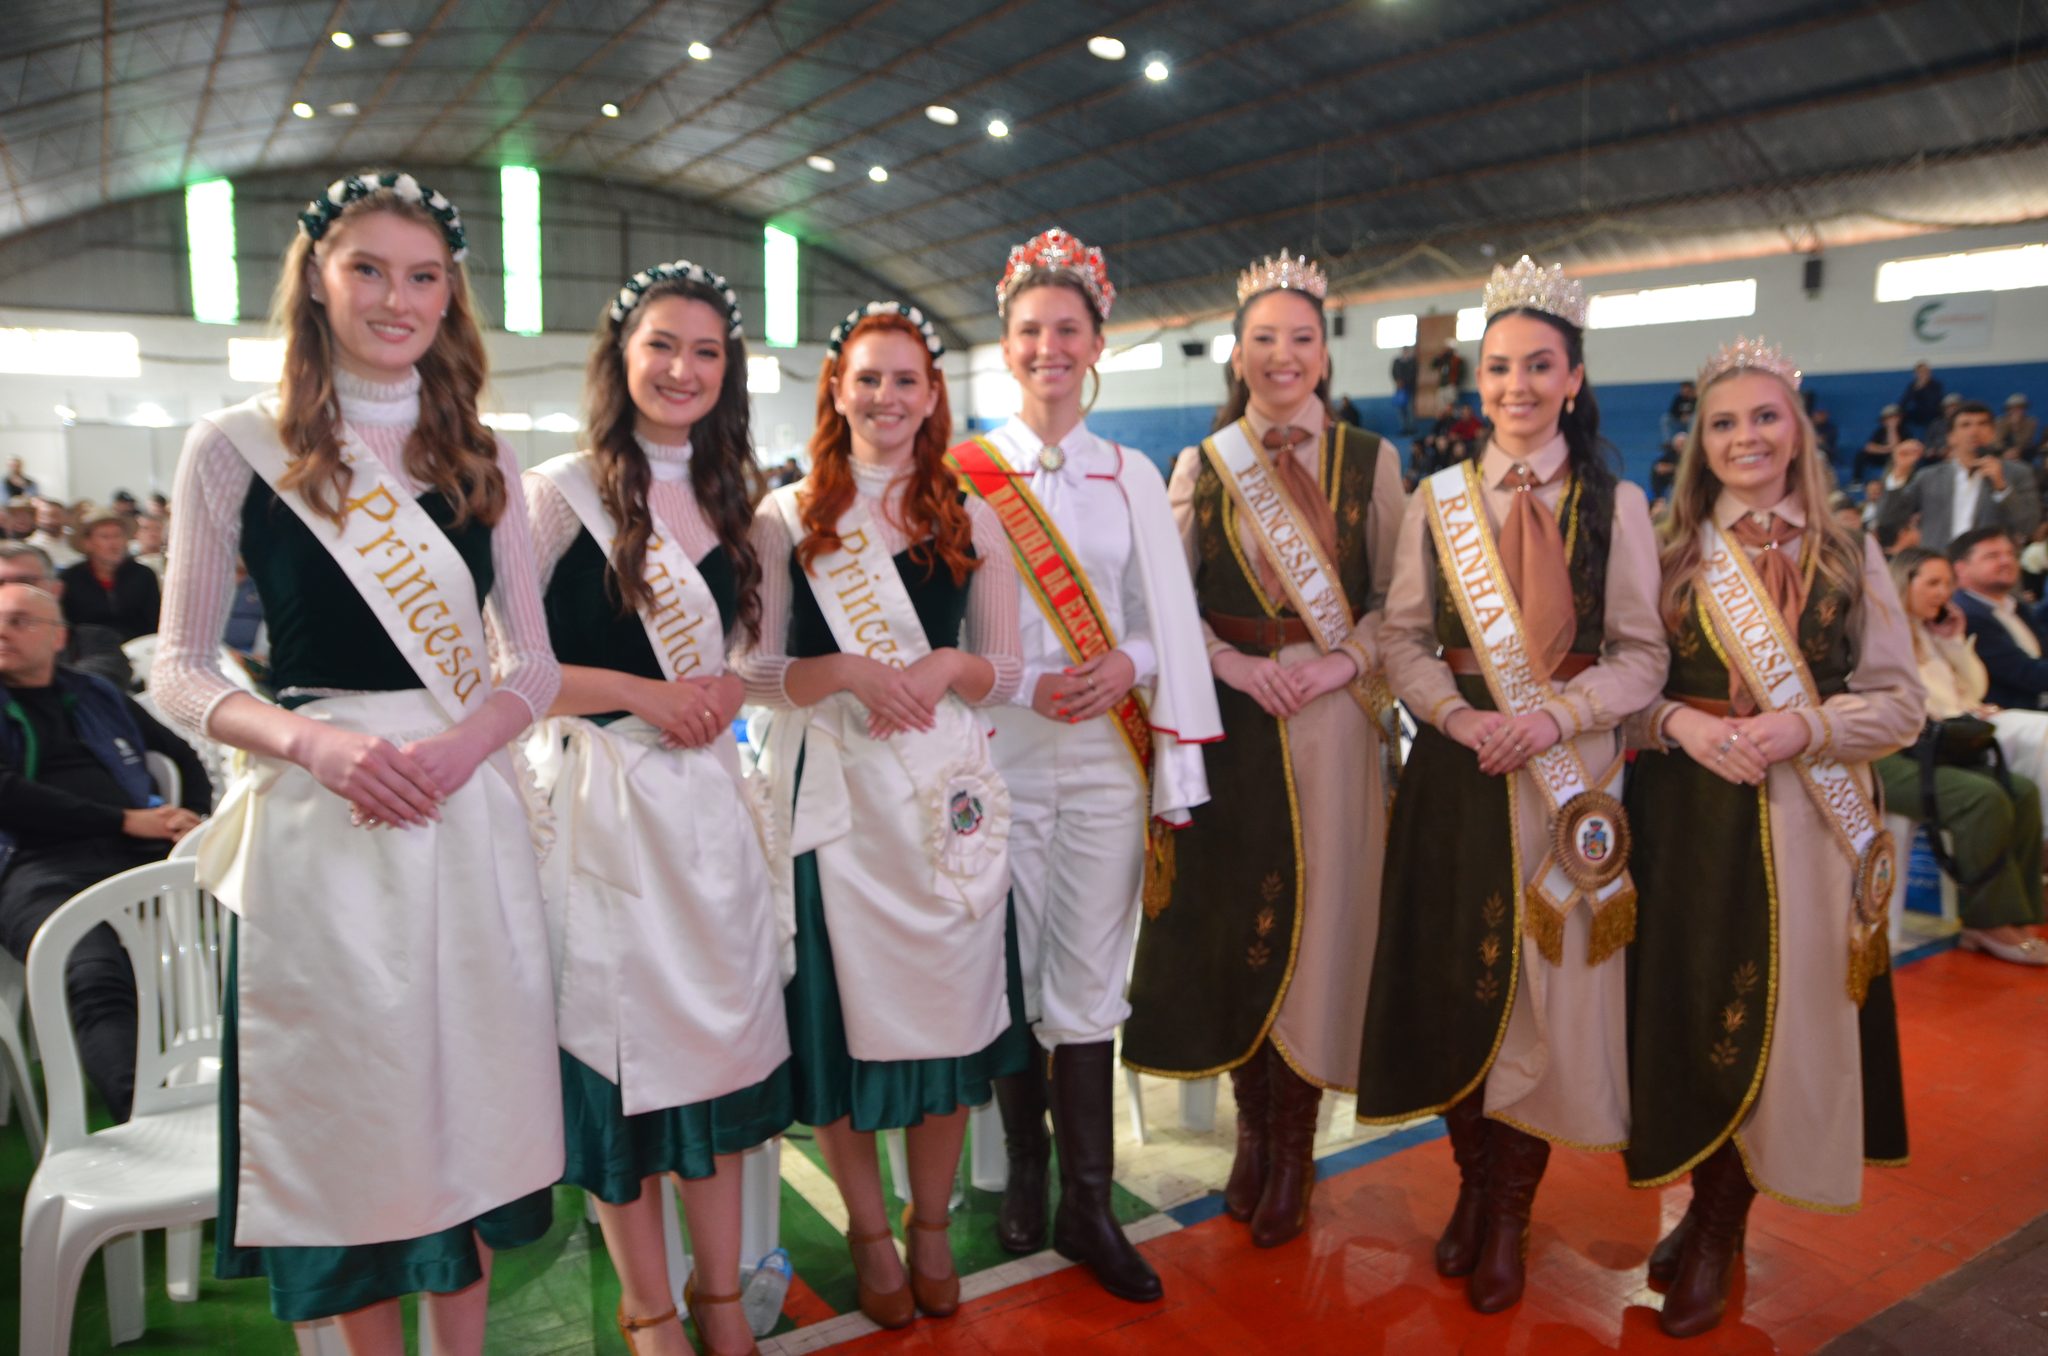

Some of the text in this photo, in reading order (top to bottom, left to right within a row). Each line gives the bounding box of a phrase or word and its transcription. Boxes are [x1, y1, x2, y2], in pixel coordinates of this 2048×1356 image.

[332, 481, 482, 706] Princesa
[1243, 474, 1320, 588] PRINCESA
[1439, 491, 1506, 634] RAINHA
[1711, 571, 1794, 692] PRINCESA
